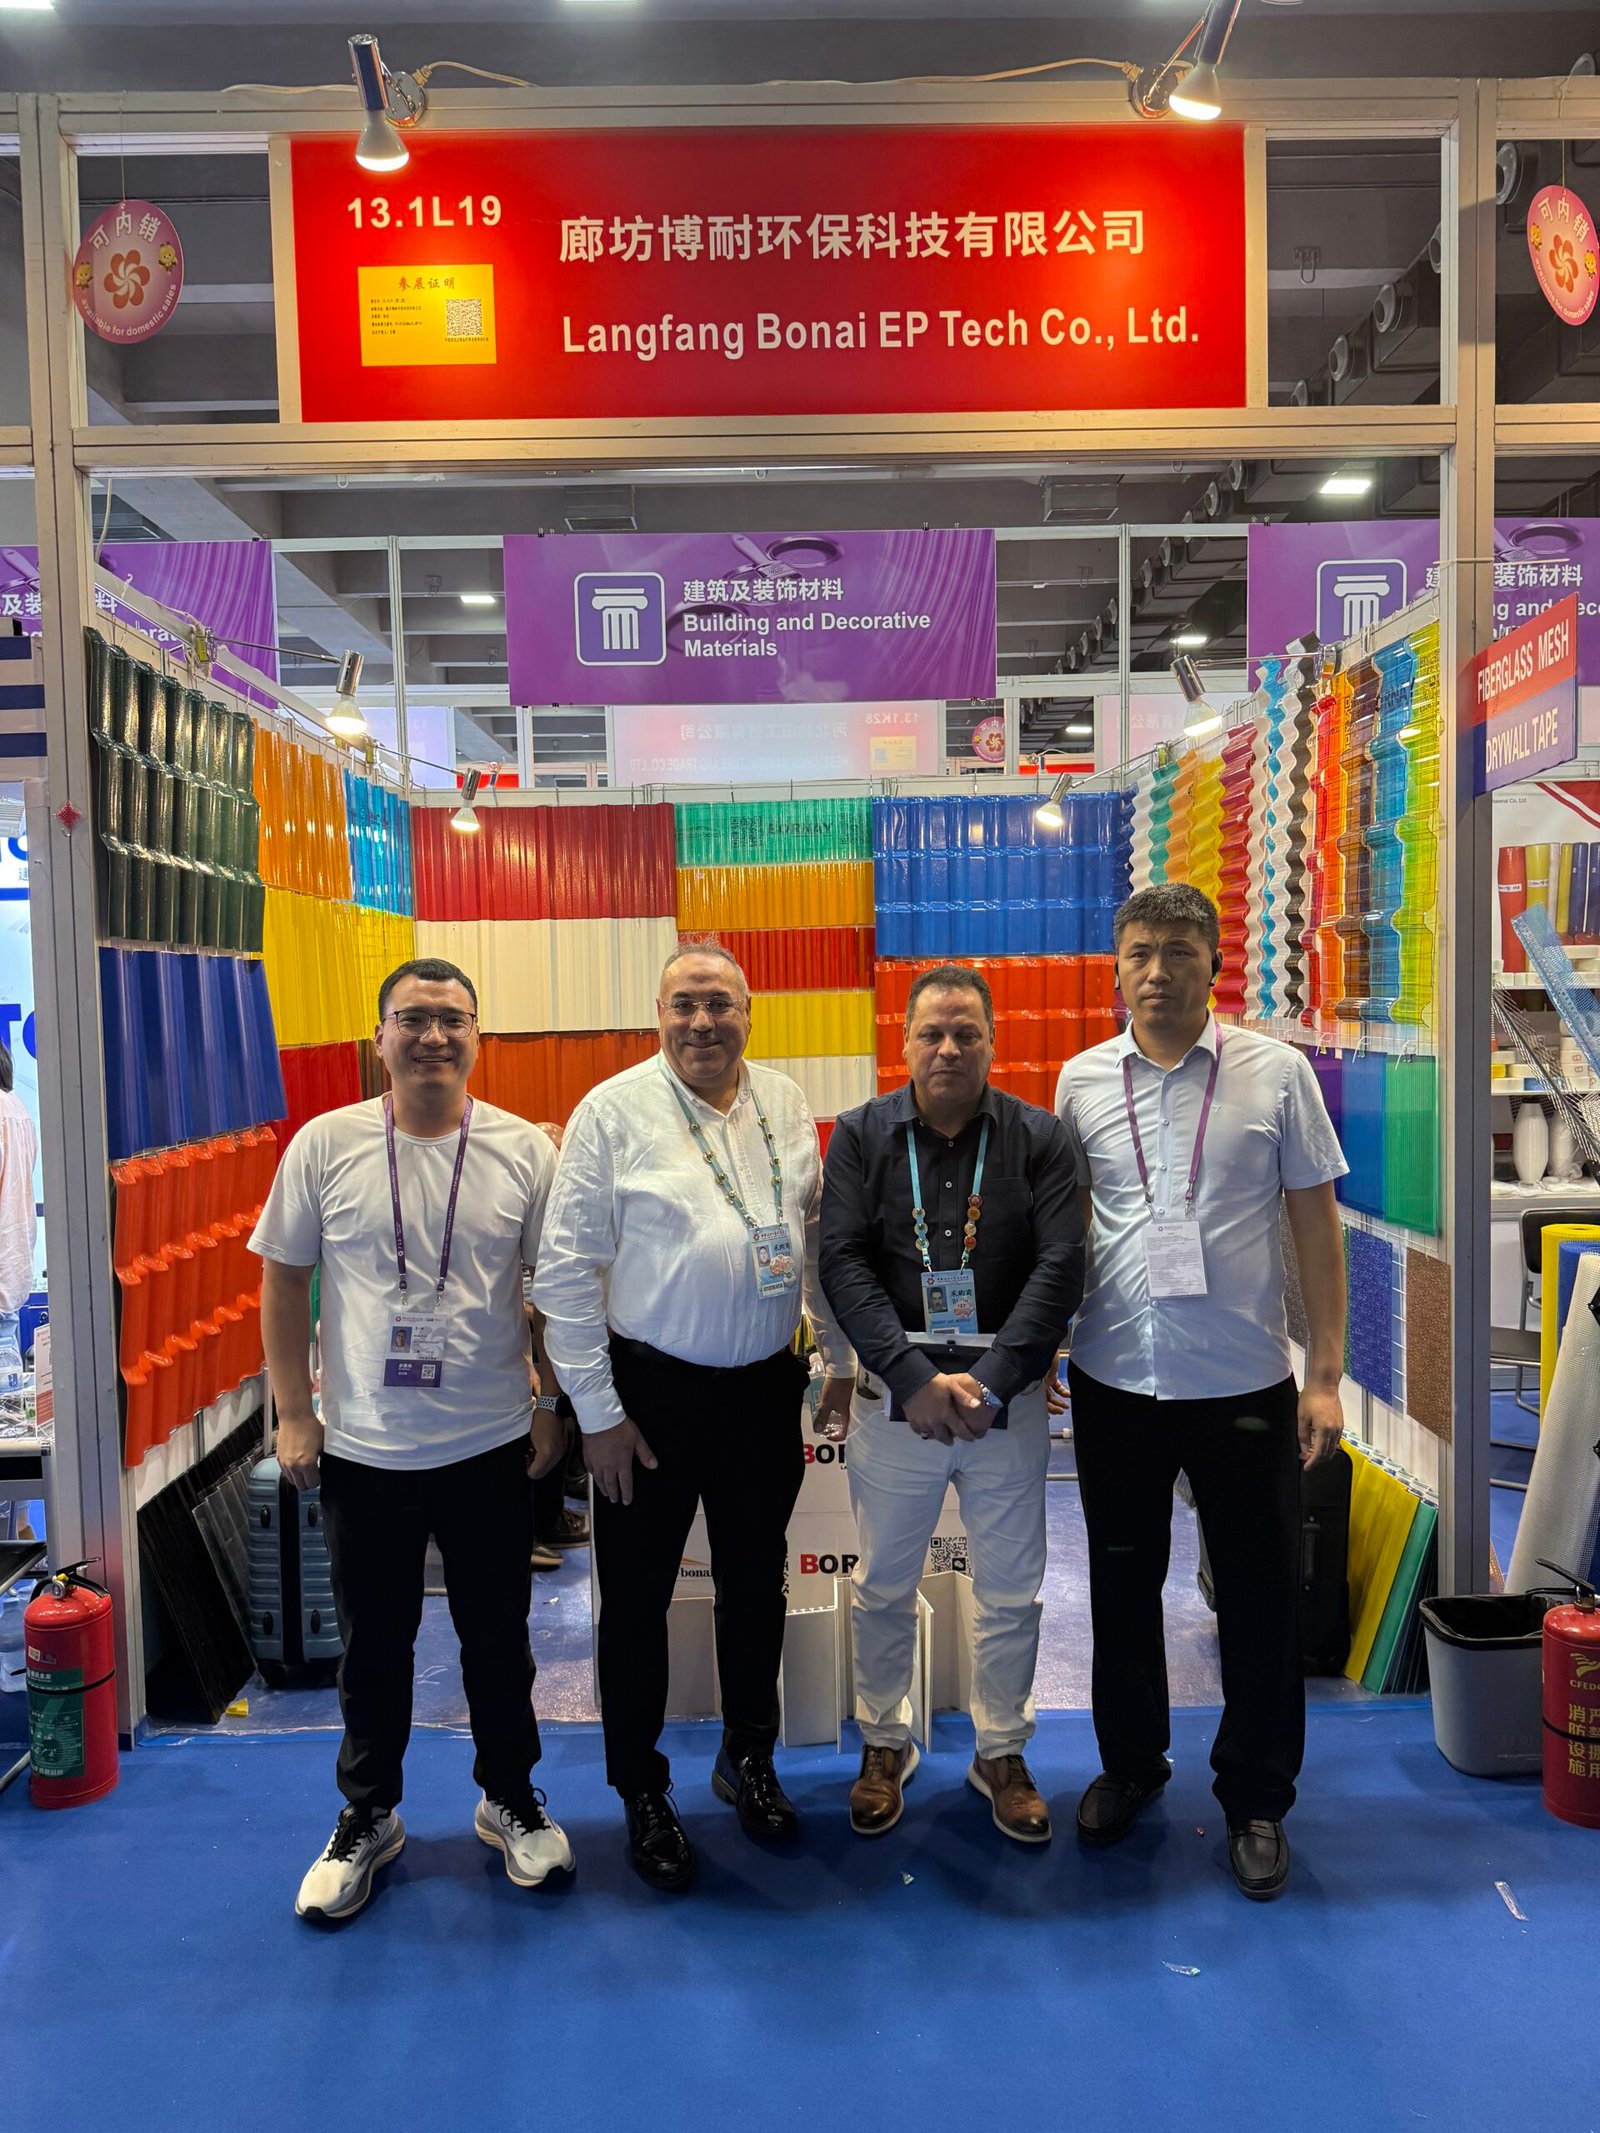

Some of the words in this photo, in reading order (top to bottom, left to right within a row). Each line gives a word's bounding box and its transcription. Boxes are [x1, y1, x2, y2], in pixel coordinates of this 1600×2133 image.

[88, 210, 161, 250] 可内销
[347, 194, 502, 229] 13.1L19
[1537, 196, 1590, 244] 可内销
[559, 209, 1145, 263] 廊坊博耐环保科技有限公司
[398, 276, 456, 292] 参展证明
[81, 298, 111, 333] available
[112, 325, 125, 337] for
[126, 312, 164, 337] domestic
[562, 313, 745, 362] Langfang
[757, 311, 867, 350] Bonai
[879, 310, 929, 349] EP
[938, 309, 1029, 348] Tech
[1040, 307, 1115, 351] Co.,
[1127, 305, 1199, 344] Ltd.
[683, 577, 844, 603] 建筑及装饰材料
[683, 613, 770, 636] Building
[776, 613, 814, 631] and
[821, 611, 931, 631] Decorative
[684, 638, 778, 658] Materials
[1477, 640, 1534, 704] FIBERGLASS
[1537, 618, 1570, 671] MESH
[1485, 722, 1531, 774] DRYWALL
[1532, 706, 1559, 753] TAPE
[681, 1567, 712, 1578] bona
